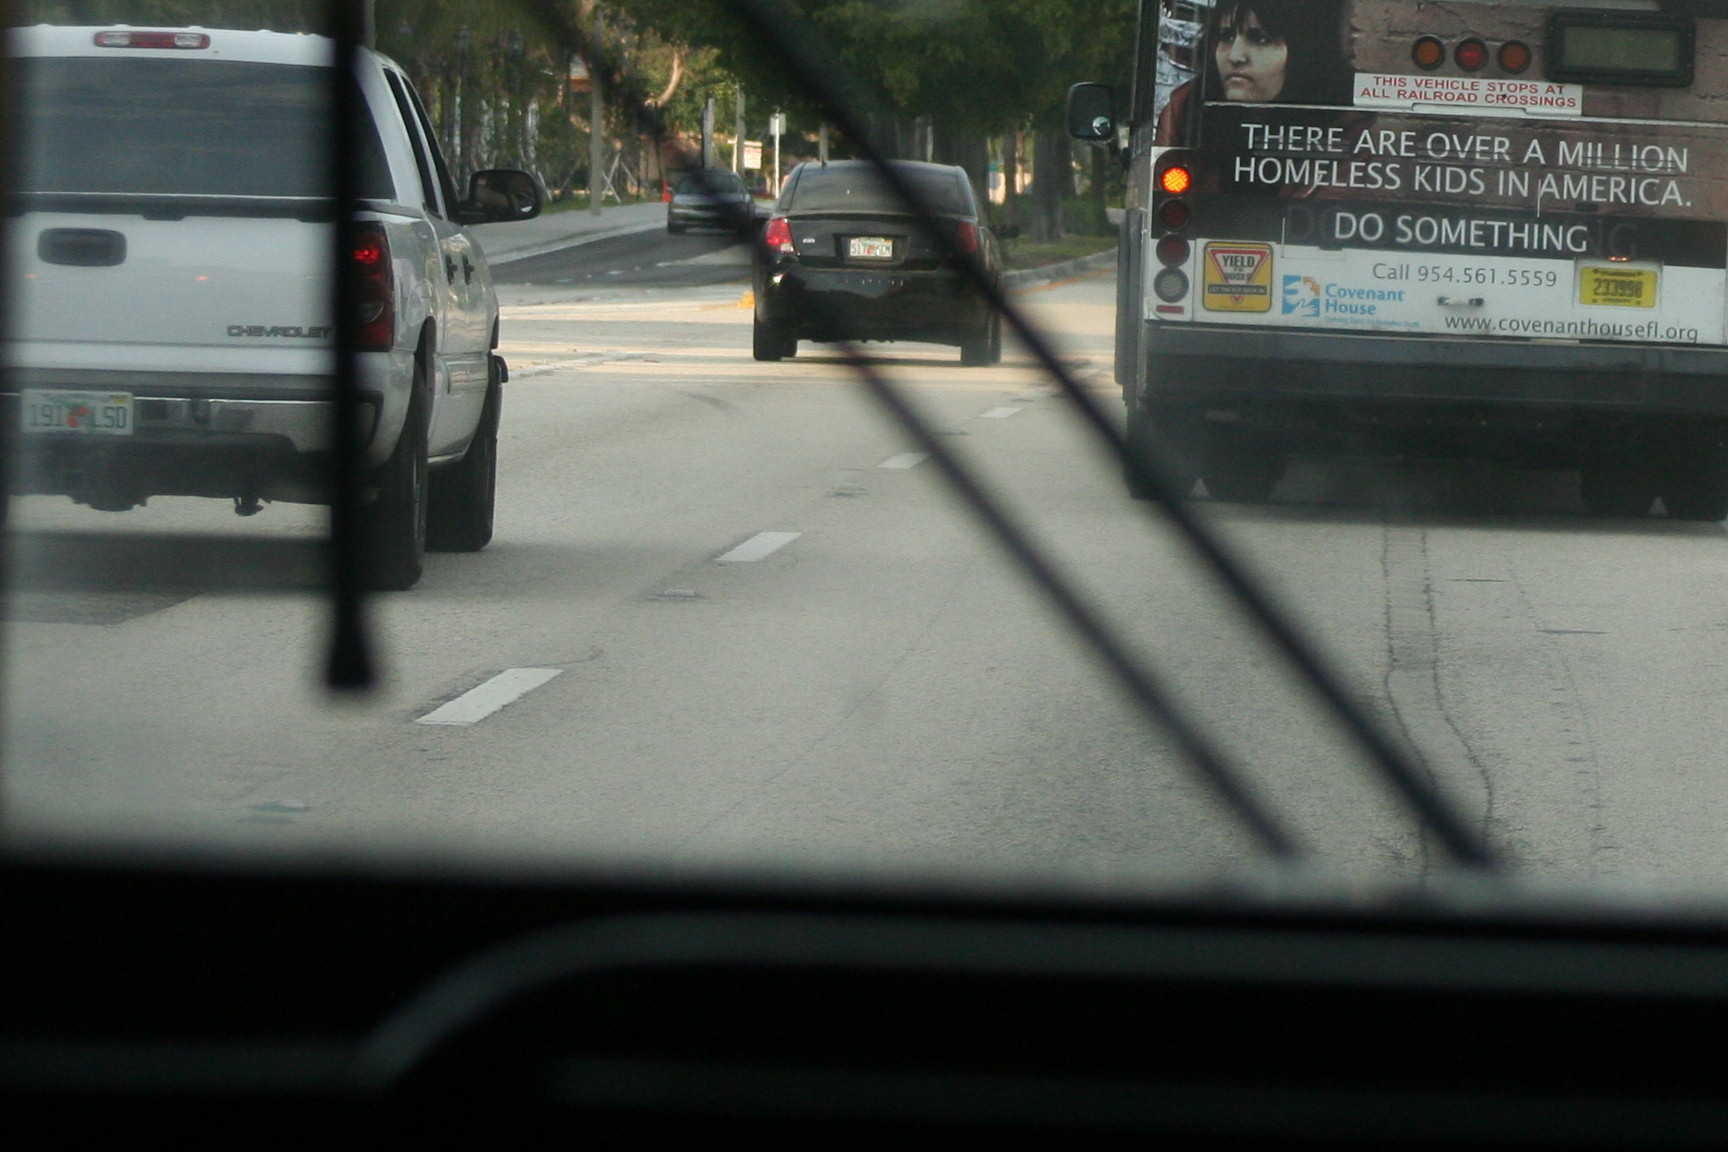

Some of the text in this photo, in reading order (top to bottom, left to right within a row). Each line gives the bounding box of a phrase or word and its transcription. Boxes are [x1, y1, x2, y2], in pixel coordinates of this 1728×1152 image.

[1373, 75, 1566, 95] THIS VEHICLE STOPS AT
[1360, 87, 1577, 108] ALL RAILROAD CROSSINGS
[1241, 123, 1688, 174] THERE ARE OVER A MILLION
[1234, 156, 1692, 208] HOMELESS KIDS IN AMERICA.
[1334, 212, 1588, 253] DO SOMETHING
[1222, 254, 1255, 268] YIELD
[1373, 262, 1557, 287] Call 954.561.5559
[1325, 283, 1405, 302] Covenant
[1325, 298, 1377, 315] House
[227, 325, 332, 338] CHEVROLET
[1445, 315, 1699, 344] www.covenanthousefl.org
